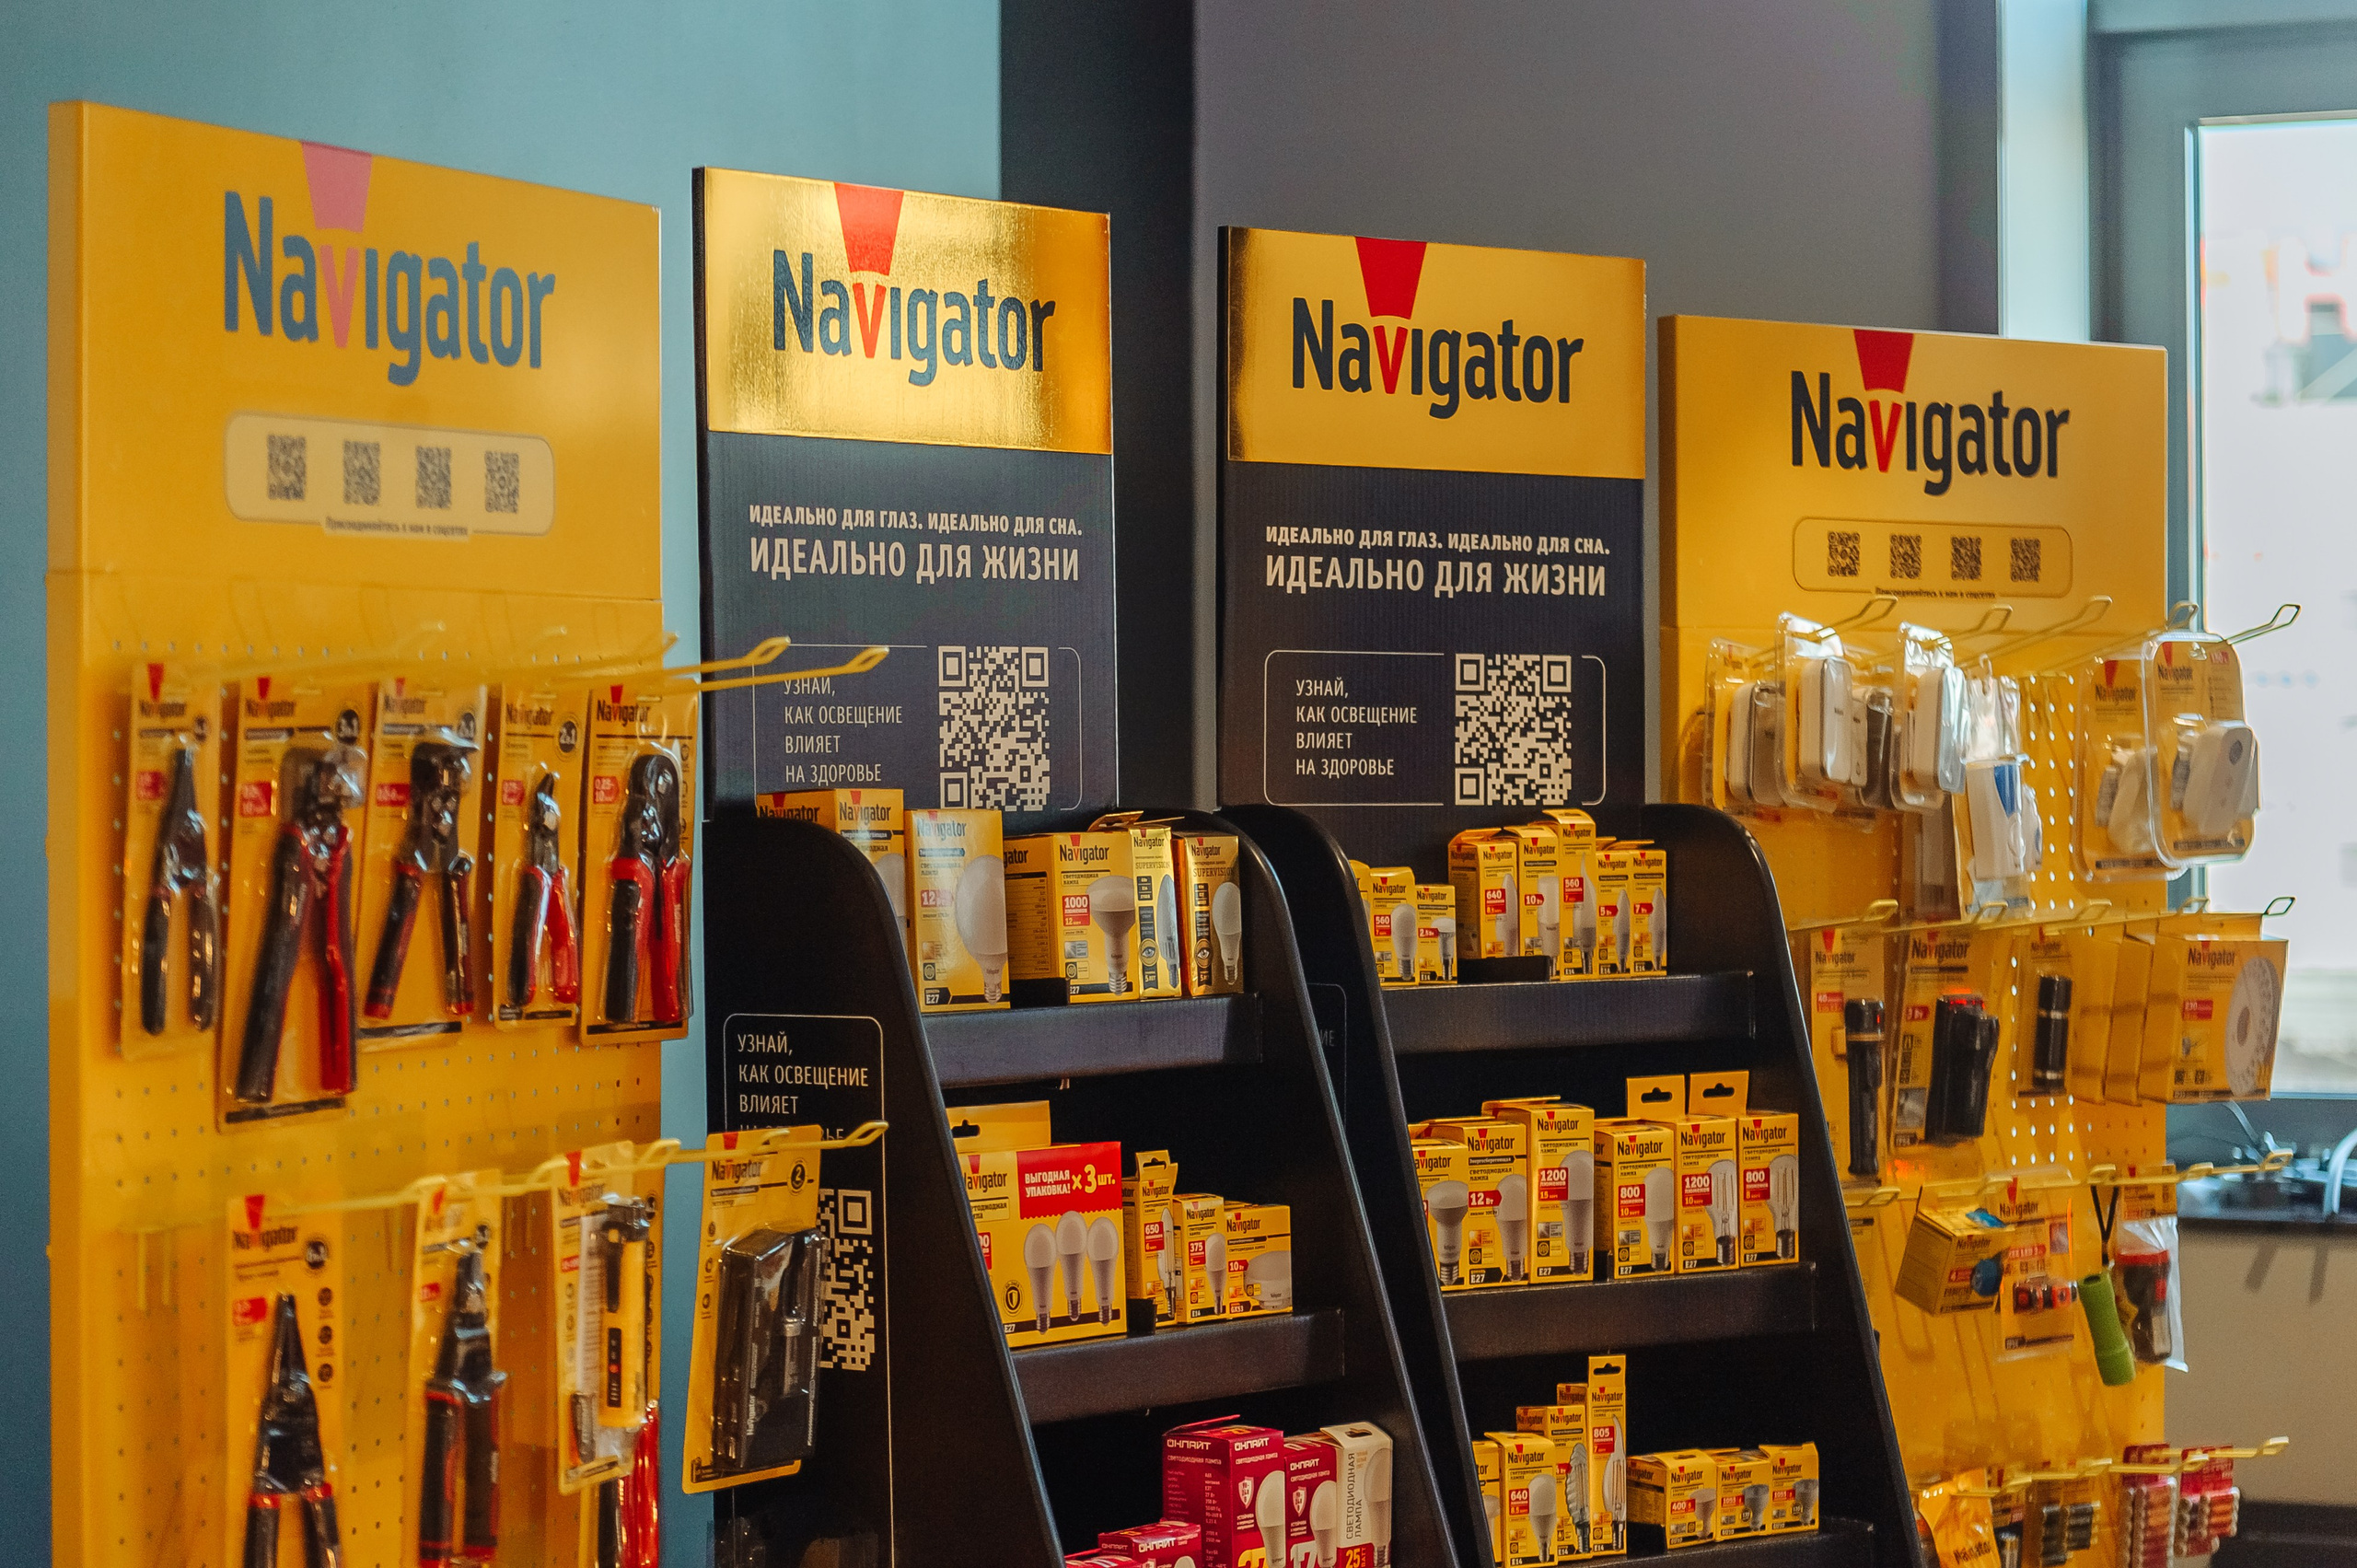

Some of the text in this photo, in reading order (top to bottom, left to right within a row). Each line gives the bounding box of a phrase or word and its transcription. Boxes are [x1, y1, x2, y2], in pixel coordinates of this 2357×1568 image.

[224, 191, 556, 387] Navigator
[773, 250, 1056, 387] Navigator
[1292, 296, 1585, 420] Navigator
[1791, 370, 2070, 496] Navigator
[749, 504, 1083, 537] ИДЕАЛЬНО ДЛЯ ГЛАЗ. ИДЕАЛЬНО ДЛЯ СНА.
[1266, 526, 1610, 555] ИДЕАЛЬНО ДЛЯ ГЛАЗ. ИДЕАЛЬНО ДЛЯ СНА.
[750, 536, 1080, 585] ИДЕАЛЬНО ДЛЯ ЖИЗНИ
[1266, 554, 1606, 598] ИДЕАЛЬНО ДЛЯ ЖИЗНИ
[1295, 677, 1349, 698] УЗНАЙ,
[784, 705, 903, 727] КАК ОСВЕЩЕНИЕ
[1296, 705, 1418, 726] КАК ОСВЕЩЕНИЕ
[785, 735, 841, 754] ВЛИЯЕТ
[1296, 732, 1353, 749] ВЛИЯЕТ
[785, 763, 882, 786] НА ЗДОРОВЬЕ
[1296, 759, 1395, 779] НА ЗДОРОВЬЕ
[839, 801, 891, 825] Navigator
[1133, 836, 1165, 849] Navigator
[1060, 843, 1109, 865] Navigator
[1373, 883, 1406, 895] Navigator
[1486, 889, 1502, 899] 640
[1064, 897, 1088, 909] 1000
[1526, 895, 1536, 904] 10
[1376, 915, 1389, 924] 560
[925, 994, 939, 1005] E27
[737, 1030, 793, 1056] УЗНАЙ,
[739, 1063, 869, 1090] КАК ОСВЕЩЕНИЕ
[739, 1094, 798, 1114] ВЛИЯЕТ
[1537, 1118, 1579, 1133] Navigator
[1681, 1132, 1725, 1148] Navigator
[1743, 1126, 1787, 1143] Navigator
[1468, 1136, 1515, 1154] Navigator
[1618, 1141, 1663, 1157] Navigator
[1415, 1156, 1452, 1171] avigator
[1469, 1167, 1512, 1175] светодиодная
[964, 1171, 1007, 1193] avigator
[1024, 1169, 1071, 1185] ВЫГОДНАЯ
[1084, 1164, 1097, 1193] 3
[1539, 1168, 1567, 1181] 1200
[1685, 1176, 1710, 1188] 1200
[1746, 1170, 1765, 1182] 800
[1025, 1183, 1071, 1198] УПАКОВКА!
[1143, 1184, 1169, 1198] Navigator
[1620, 1186, 1640, 1198] 800
[1470, 1192, 1484, 1206] 12
[1620, 1207, 1629, 1215] 10
[1144, 1223, 1160, 1235] 650
[1226, 1218, 1260, 1234] Navigator
[1190, 1242, 1203, 1252] 375
[1229, 1261, 1238, 1272] 10
[1538, 1268, 1551, 1276] E27
[1620, 1266, 1632, 1274] E27
[1685, 1260, 1697, 1269] E27
[1470, 1274, 1485, 1283] E27
[1592, 1391, 1623, 1404] Navigator
[1594, 1427, 1609, 1438] 805
[1167, 1439, 1212, 1450] ОНЛАЙТ
[1234, 1437, 1270, 1452] ОНЛАЙТ
[1290, 1458, 1320, 1471] ОНЛАЙТ
[1507, 1451, 1545, 1465] Navigator
[1346, 1453, 1356, 1539] СВЕТОДИОДНАЯ
[1510, 1490, 1527, 1501] 640
[1672, 1501, 1687, 1511] 400
[1354, 1499, 1363, 1538] ЛАМПА
[1138, 1539, 1175, 1553] ОНЛАЙТ
[1345, 1548, 1361, 1568] 25
